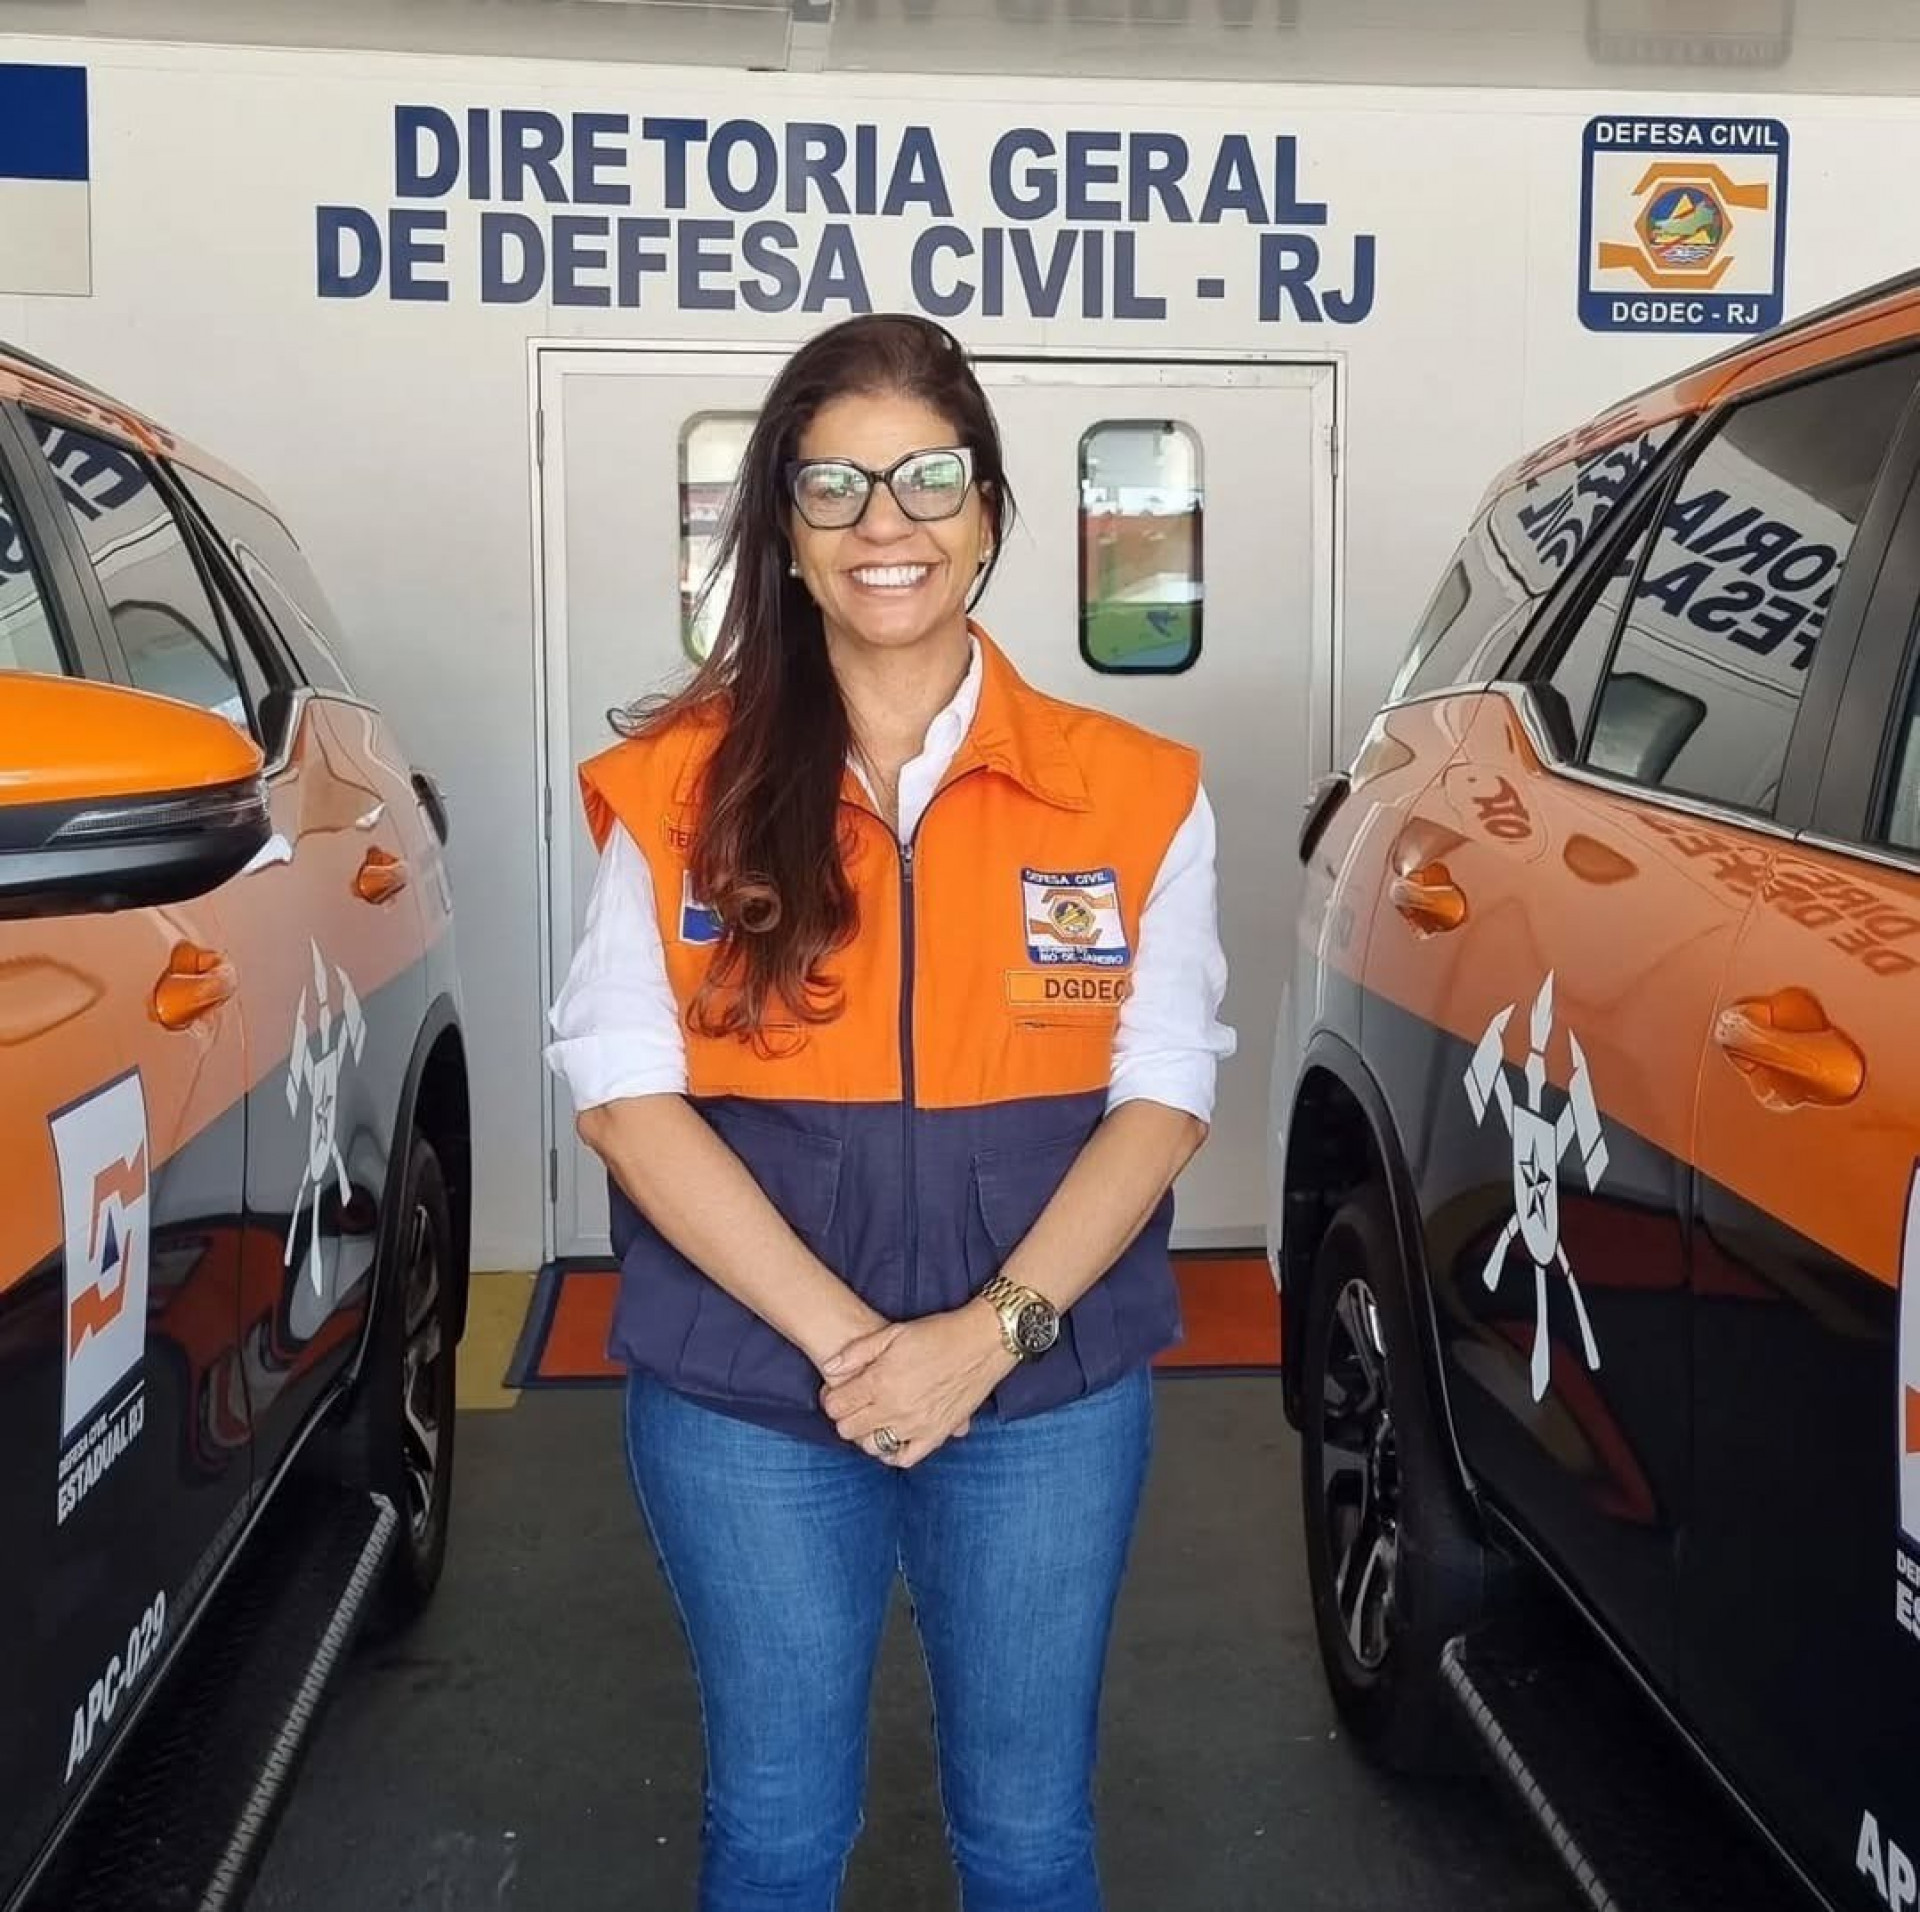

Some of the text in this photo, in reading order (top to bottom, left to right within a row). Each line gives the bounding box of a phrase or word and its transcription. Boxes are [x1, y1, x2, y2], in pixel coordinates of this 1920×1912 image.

[394, 104, 1328, 224] DIRETORIA GERAL
[1595, 122, 1779, 147] DEFESA CIVIL
[316, 205, 1376, 325] DE DEFESA CIVIL - RJ
[1612, 301, 1760, 324] DGDEC - RJ
[64, 1589, 166, 1785] APC-029
[1855, 1808, 1920, 1912] AP
